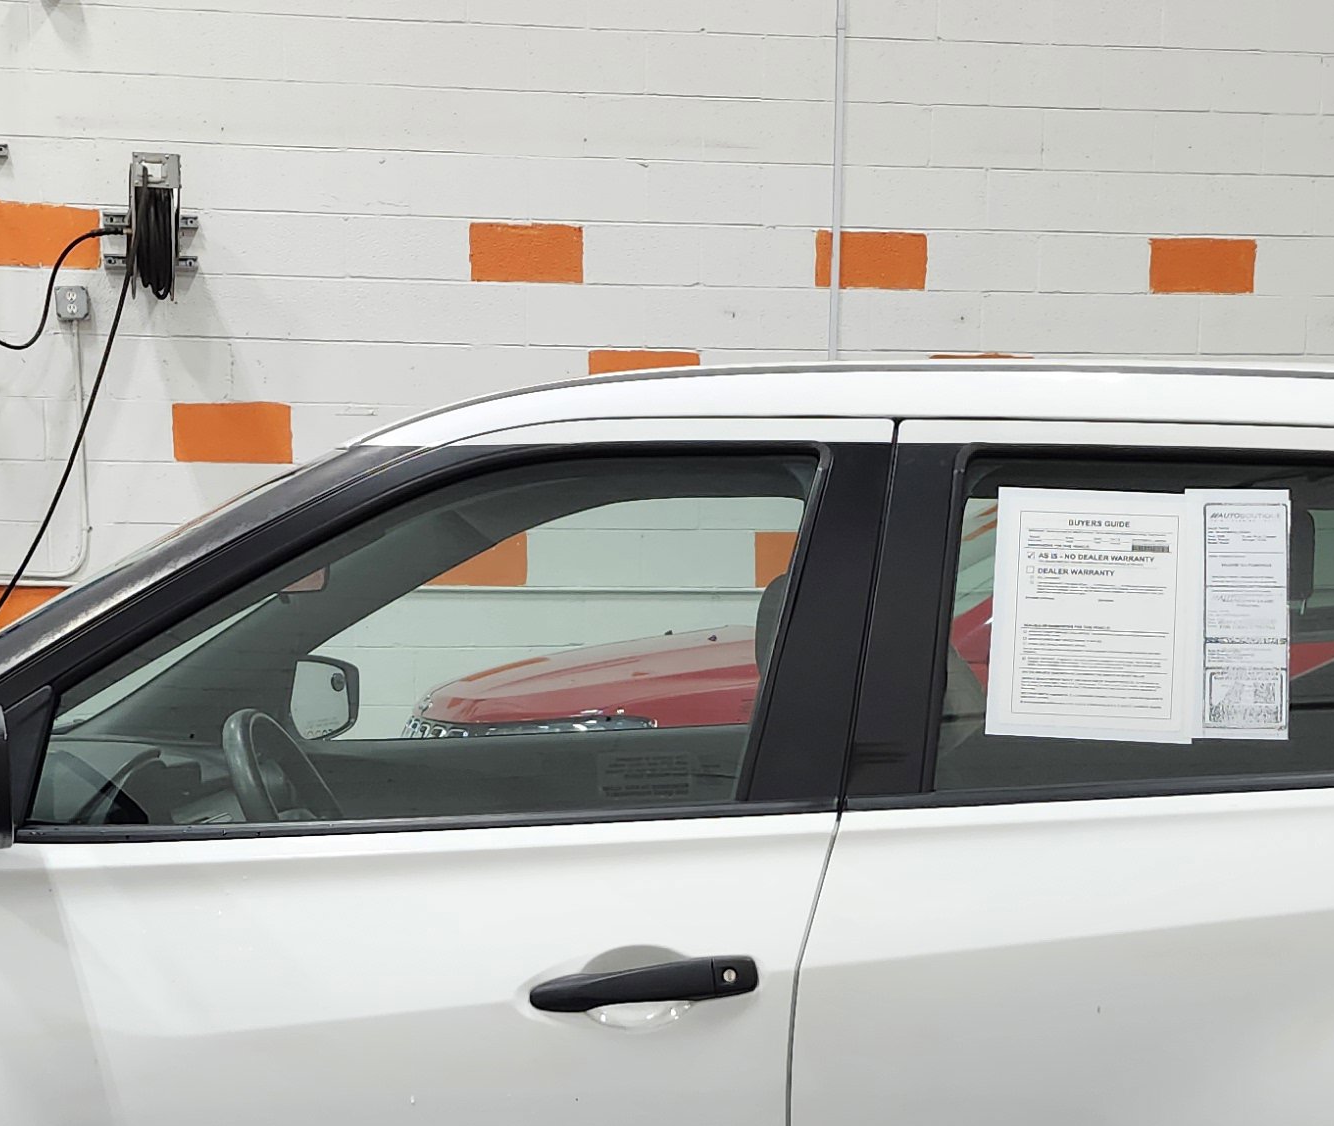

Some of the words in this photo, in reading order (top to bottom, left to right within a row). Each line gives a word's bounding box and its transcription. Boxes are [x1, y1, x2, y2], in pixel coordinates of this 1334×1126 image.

[1068, 519, 1102, 527] BUYERS
[1104, 520, 1131, 528] GUIDE
[1038, 552, 1049, 560] AS
[1050, 553, 1058, 561] IS
[1064, 553, 1077, 561] NO
[1078, 554, 1109, 562] DEALER
[1110, 555, 1155, 564] WARRANTY
[1037, 567, 1069, 576] DEALER
[1070, 568, 1115, 577] WARRANTY
